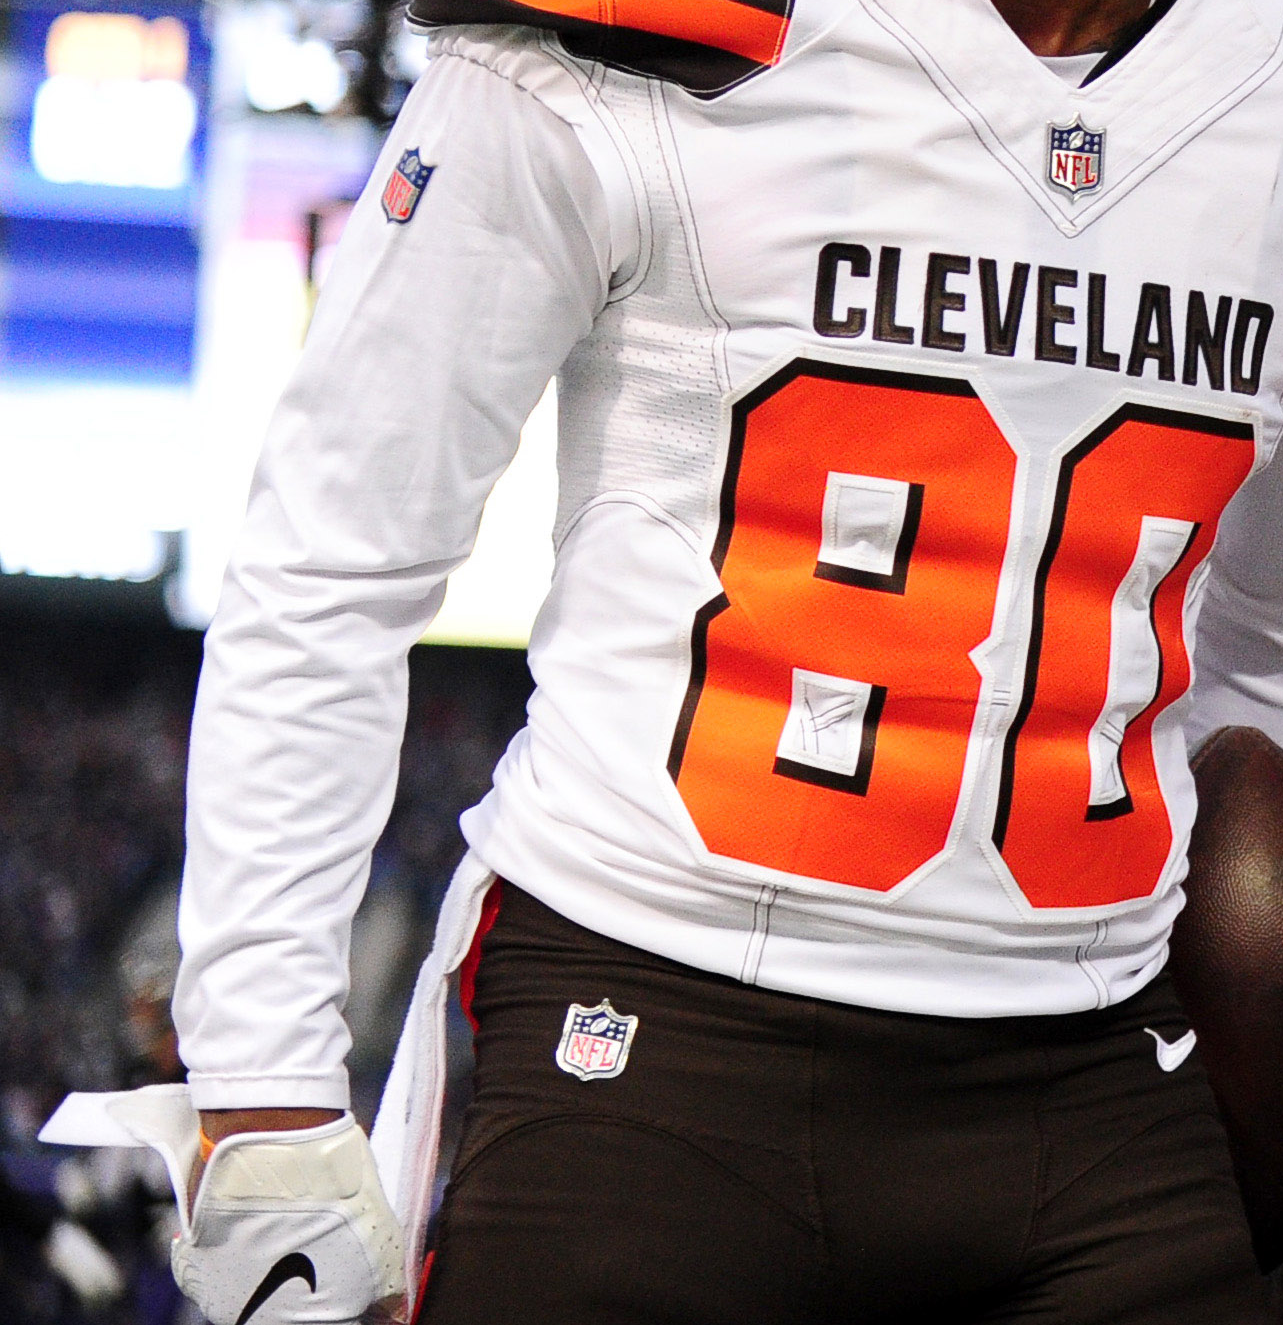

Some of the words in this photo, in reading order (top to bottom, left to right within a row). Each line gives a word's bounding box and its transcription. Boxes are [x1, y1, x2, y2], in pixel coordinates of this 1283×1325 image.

[1054, 152, 1096, 186] NFL
[813, 242, 1275, 395] CLEVELAND
[666, 356, 1256, 908] 80
[570, 1034, 613, 1068] NFL
